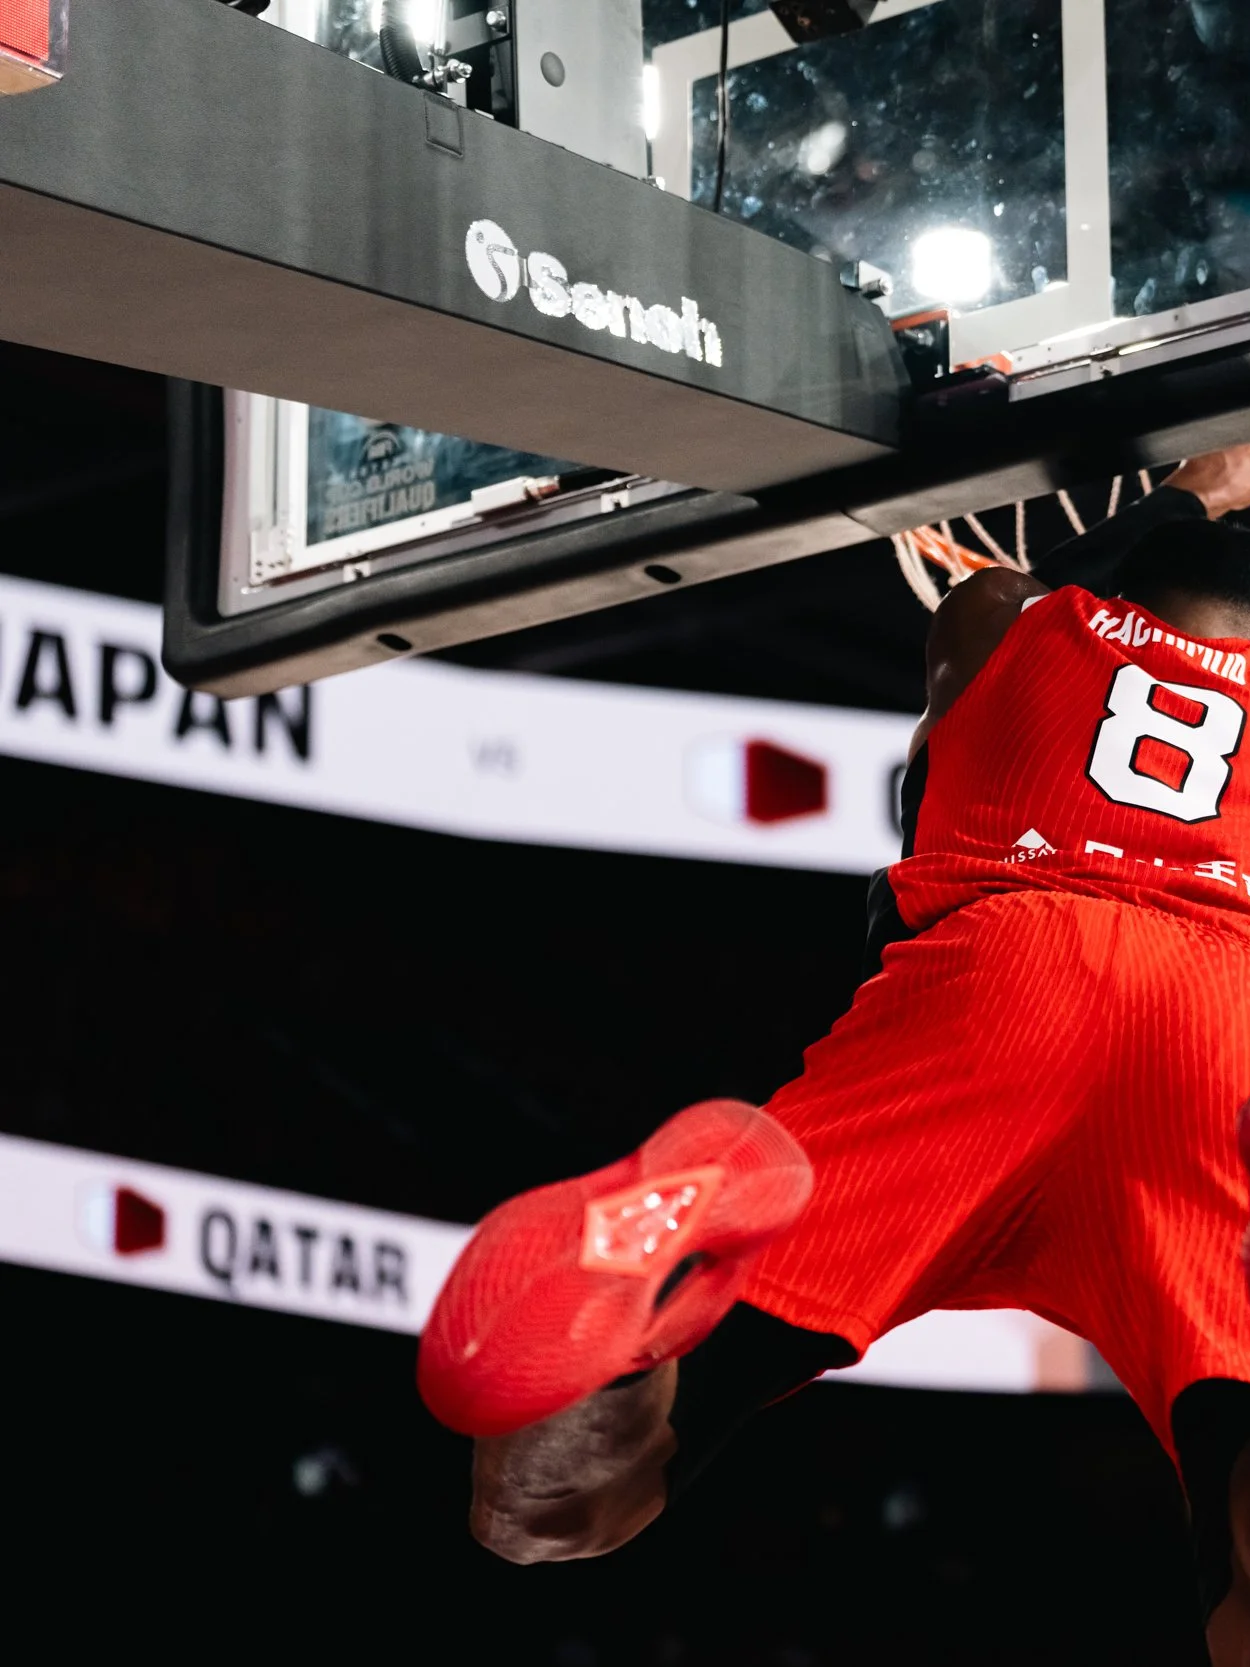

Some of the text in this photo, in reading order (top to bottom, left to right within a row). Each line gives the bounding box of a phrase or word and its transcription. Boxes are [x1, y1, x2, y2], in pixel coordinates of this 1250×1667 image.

[0, 615, 312, 762] APAN
[1084, 663, 1248, 825] 8
[200, 1207, 411, 1305] QATAR
